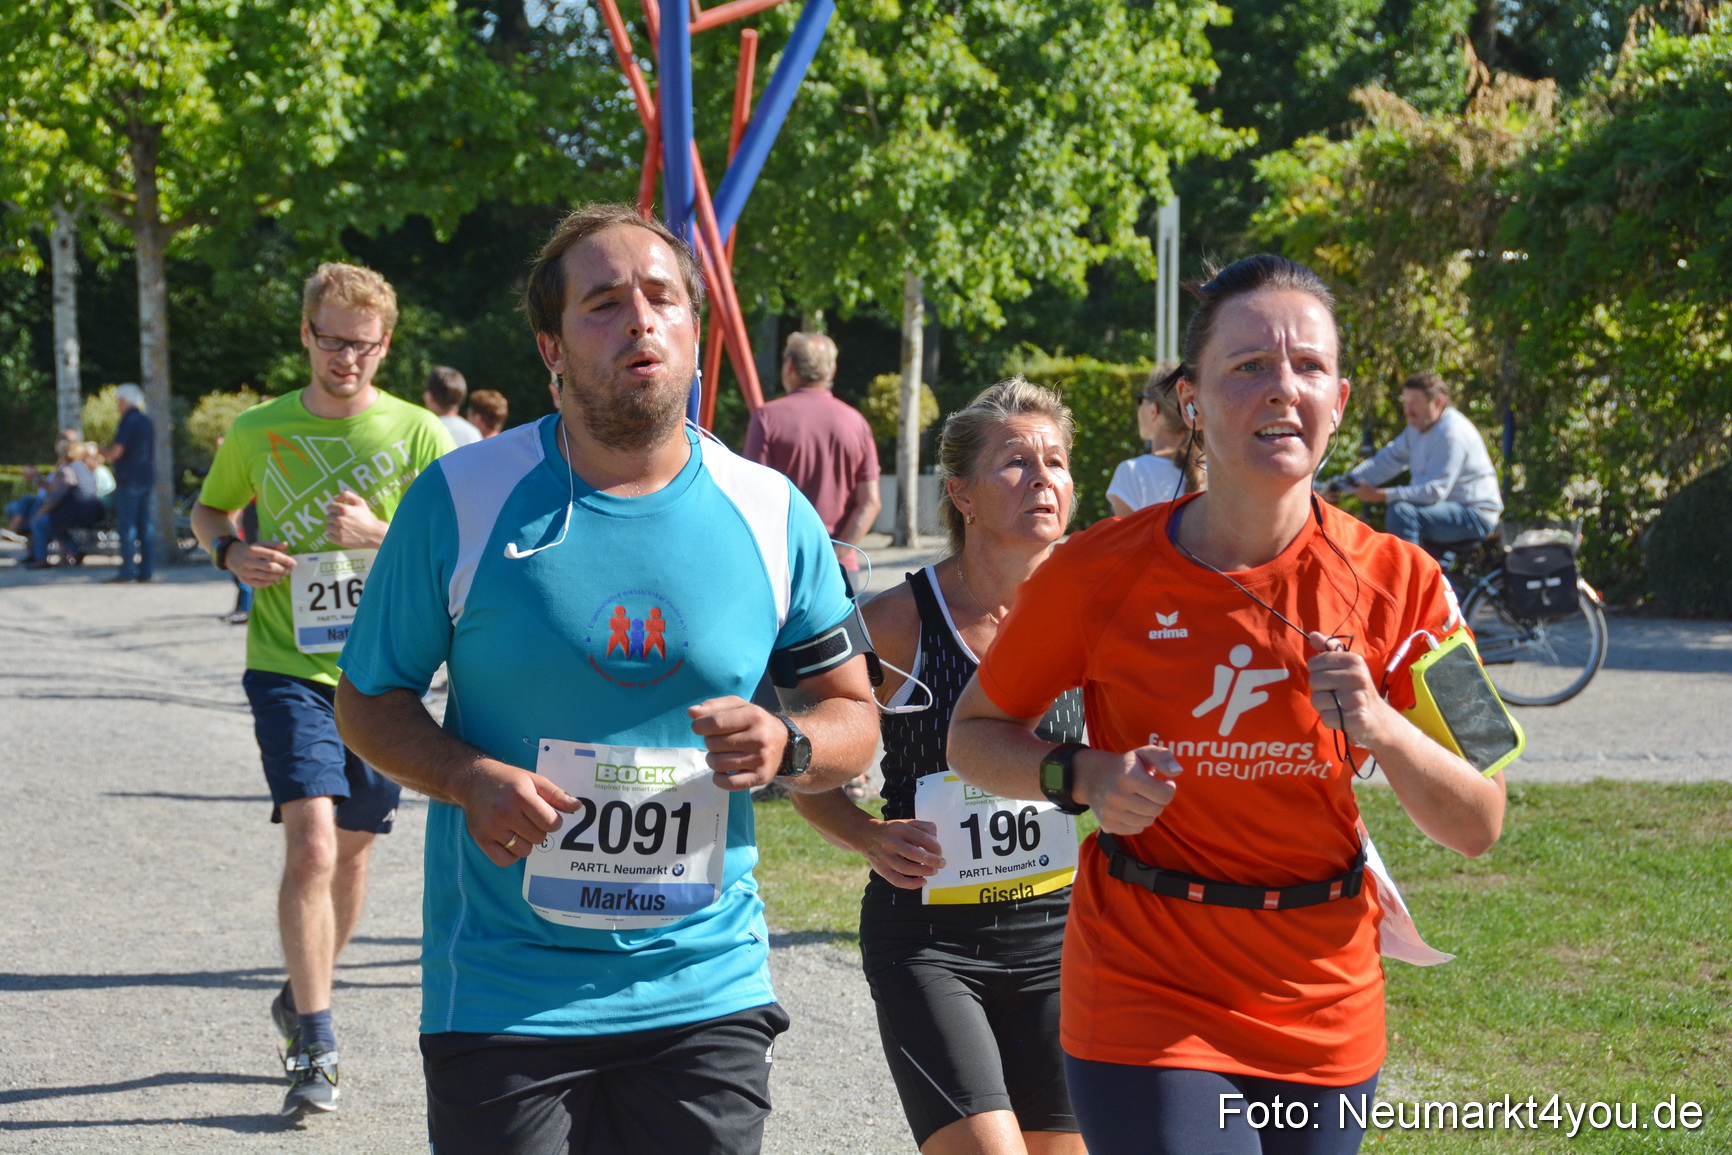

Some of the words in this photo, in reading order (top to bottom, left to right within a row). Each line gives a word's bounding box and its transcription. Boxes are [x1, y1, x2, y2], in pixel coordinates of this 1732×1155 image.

[271, 440, 411, 547] RKHARDT
[320, 559, 366, 573] BOCK
[308, 579, 364, 611] 216
[327, 629, 351, 641] Nat
[1148, 627, 1188, 640] erima
[595, 763, 677, 785] BOCK
[1197, 759, 1332, 780] neumarkt
[594, 783, 620, 791] inspired
[622, 784, 630, 792] by
[560, 797, 691, 855] 2091
[960, 805, 1041, 860] 196
[570, 861, 611, 874] PARTL
[614, 864, 667, 875] Neumarkt
[959, 868, 993, 879] PARTL
[995, 859, 1036, 875] Neumarkt
[580, 886, 666, 911] Markus
[979, 882, 1034, 904] Gisela
